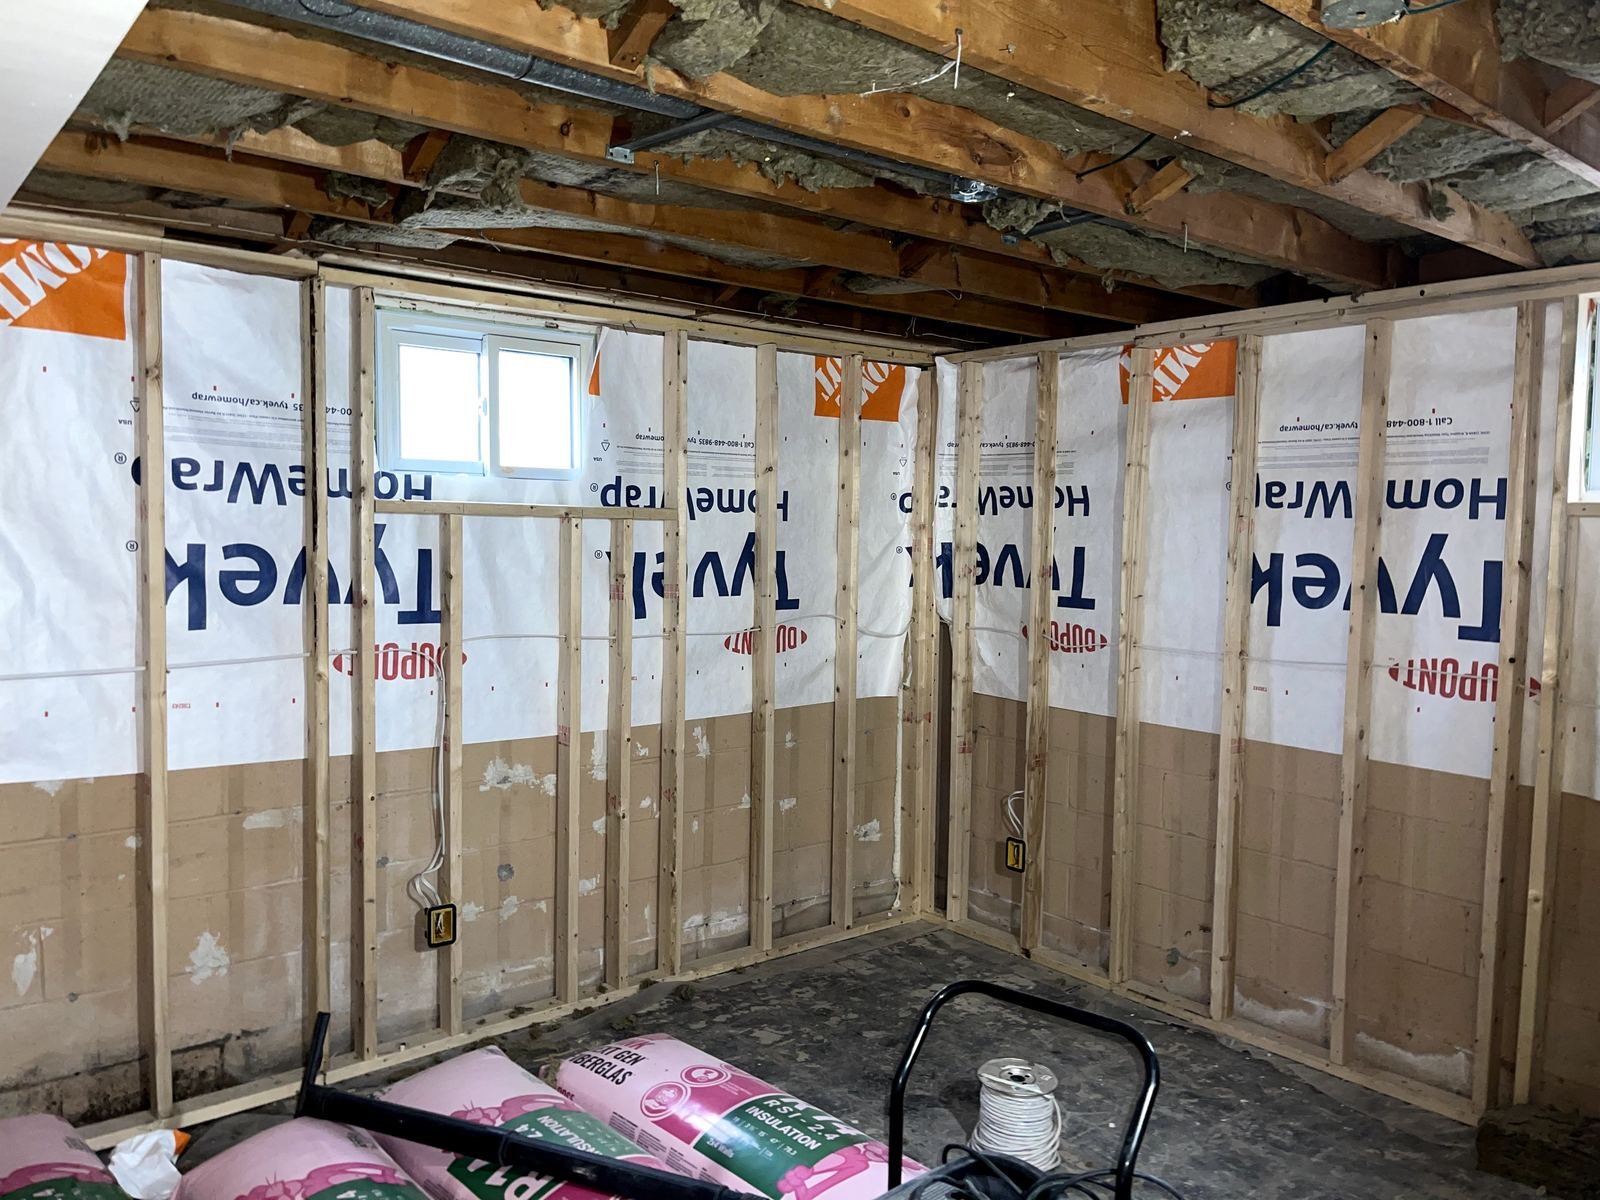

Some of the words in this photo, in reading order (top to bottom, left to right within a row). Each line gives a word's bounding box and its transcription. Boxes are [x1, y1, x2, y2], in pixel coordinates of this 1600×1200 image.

[191, 391, 289, 411] tyvek.ca/homewrap
[1278, 420, 1359, 434] tyvek.ca/homewrap
[1385, 416, 1432, 428] 1-800-448
[1435, 416, 1453, 428] Call
[698, 438, 744, 448] 1-800-448-9835
[743, 441, 755, 450] Call
[131, 454, 433, 506] HomeWra
[1254, 473, 1507, 520] HomWra
[732, 624, 797, 656] DUNT
[1050, 621, 1096, 654] DUPO
[1402, 657, 1499, 703] UPONT
[613, 1049, 645, 1066] GEN
[535, 1114, 604, 1156] NSULATION
[745, 1106, 822, 1151] INSULATION
